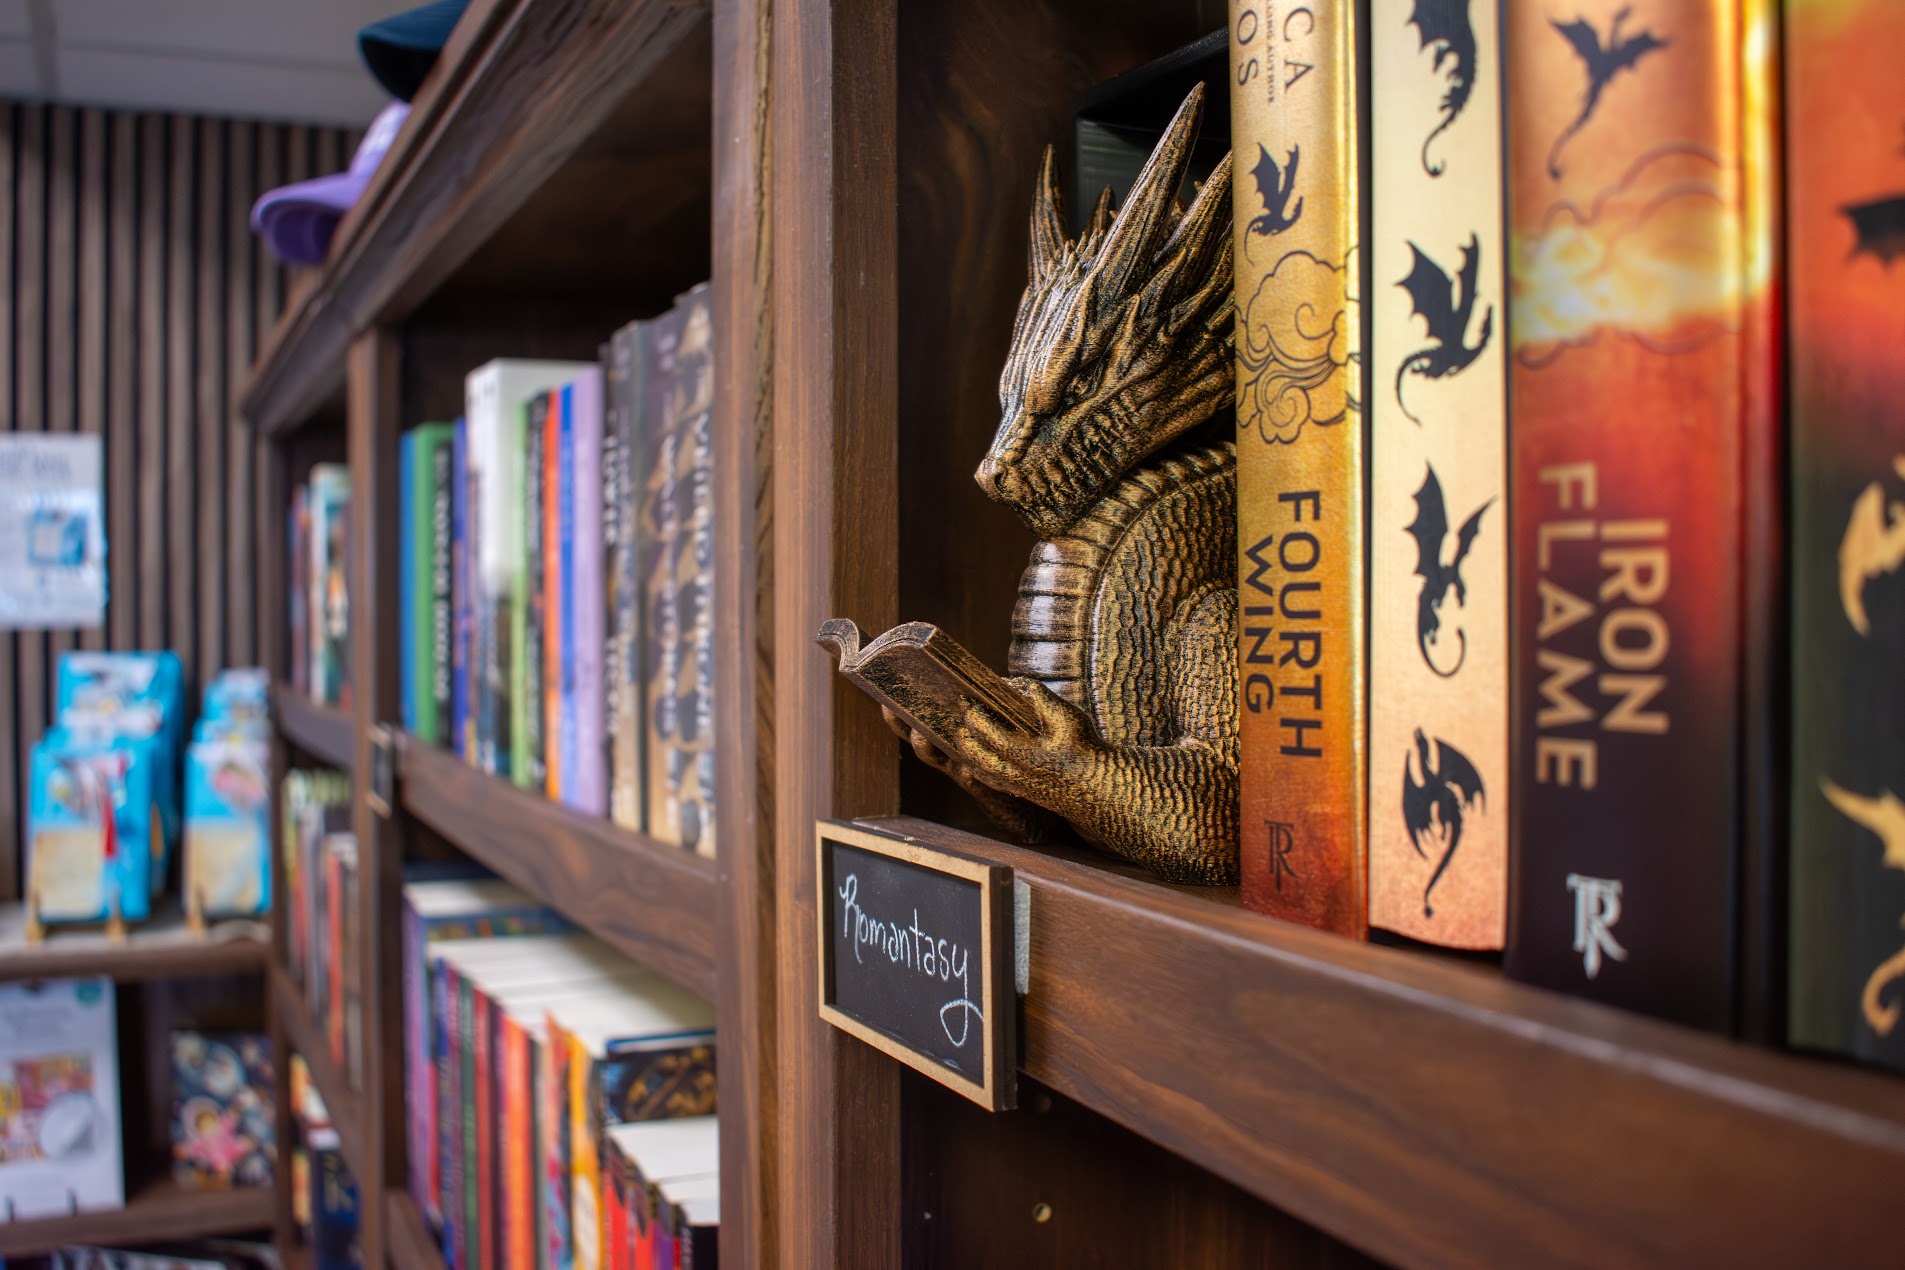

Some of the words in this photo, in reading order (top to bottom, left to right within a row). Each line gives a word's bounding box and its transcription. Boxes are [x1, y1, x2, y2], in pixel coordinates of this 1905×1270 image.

[1237, 0, 1258, 87] OS
[1244, 534, 1274, 714] WING
[1278, 490, 1323, 759] FOURTH
[1535, 460, 1597, 790] FLAME
[1599, 519, 1670, 734] IRON
[839, 873, 984, 1047] Romantasy
